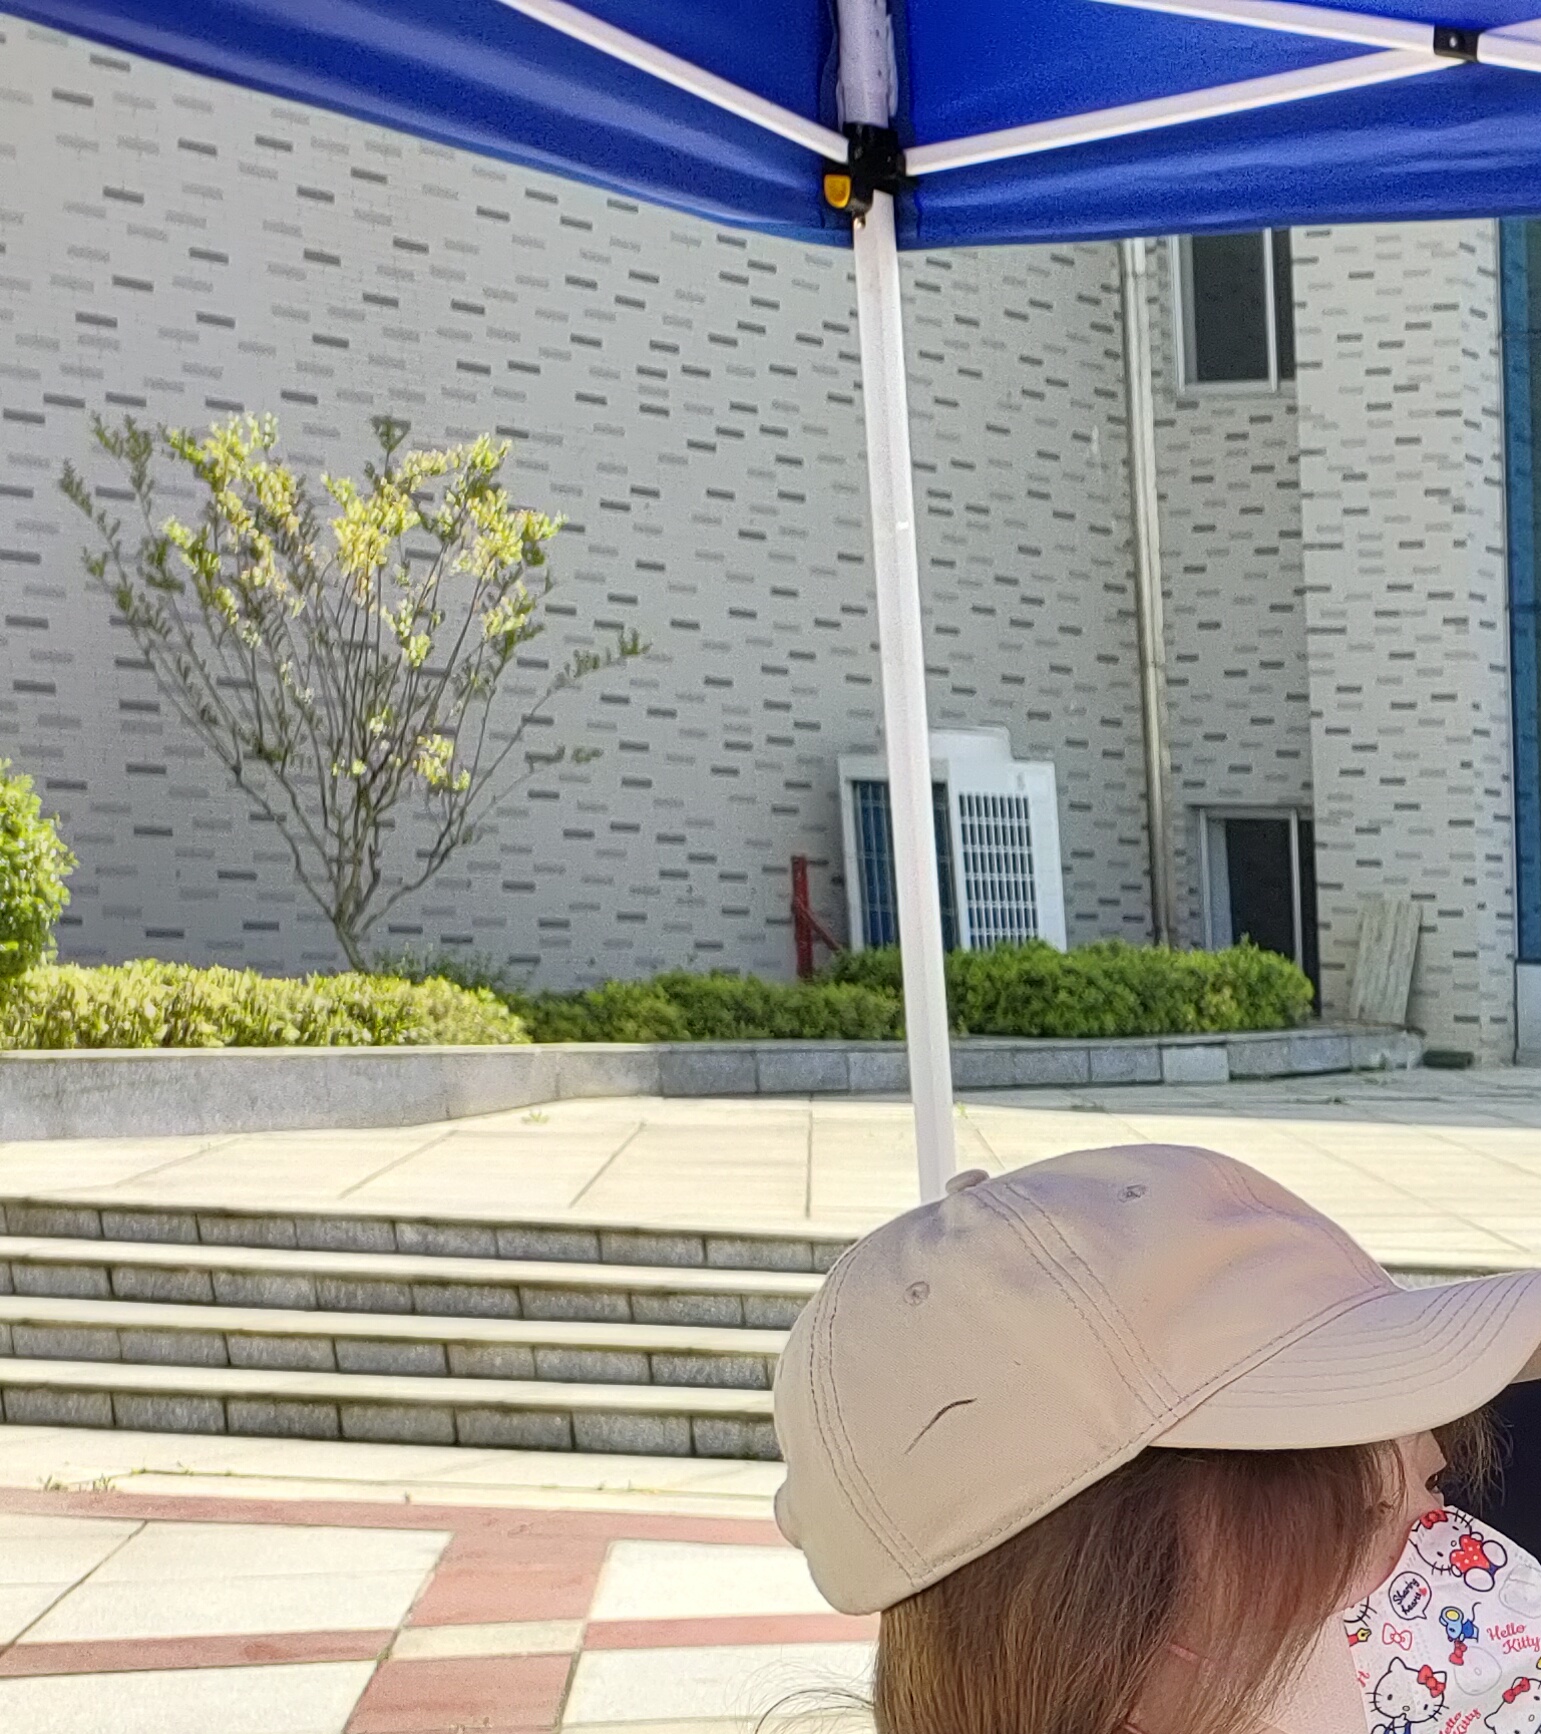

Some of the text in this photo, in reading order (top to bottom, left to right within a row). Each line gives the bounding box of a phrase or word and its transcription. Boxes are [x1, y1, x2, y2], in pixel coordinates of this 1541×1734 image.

[1392, 1578, 1420, 1606] Sharing
[1486, 1621, 1526, 1642] Hello
[1502, 1634, 1541, 1656] Kitty
